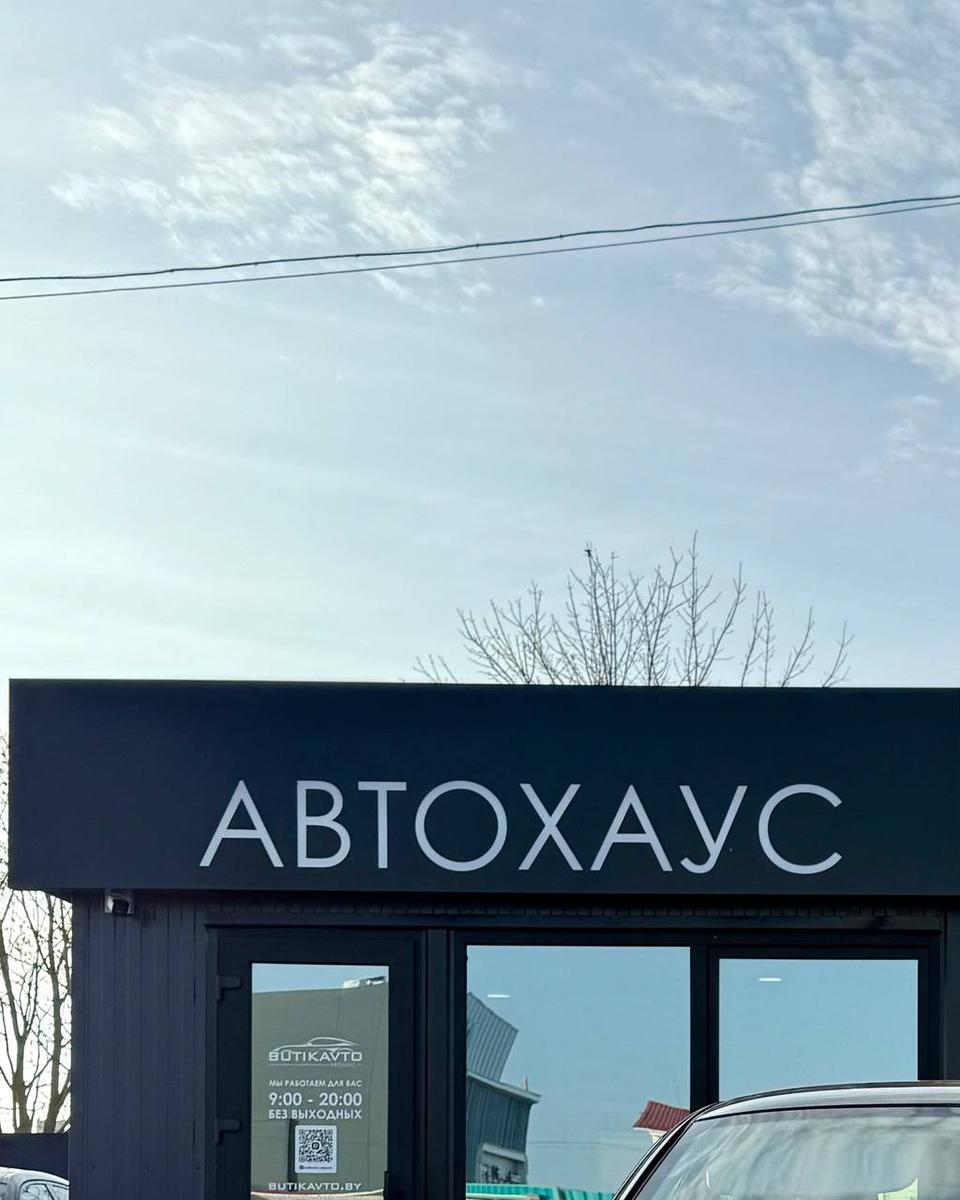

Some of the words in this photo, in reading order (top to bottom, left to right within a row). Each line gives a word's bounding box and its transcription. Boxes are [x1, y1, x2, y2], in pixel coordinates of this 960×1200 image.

[200, 779, 843, 875] АВТОХАУС
[268, 1051, 363, 1062] BUTIKAVTO
[328, 1080, 344, 1088] ДЛЯ
[268, 1092, 303, 1106] 9:00
[319, 1092, 363, 1106] 20:00
[268, 1109, 288, 1119] БЕЗ
[291, 1109, 362, 1120] ВЫХОДНЫХ
[268, 1182, 362, 1191] BUTIKAVTO.BY
